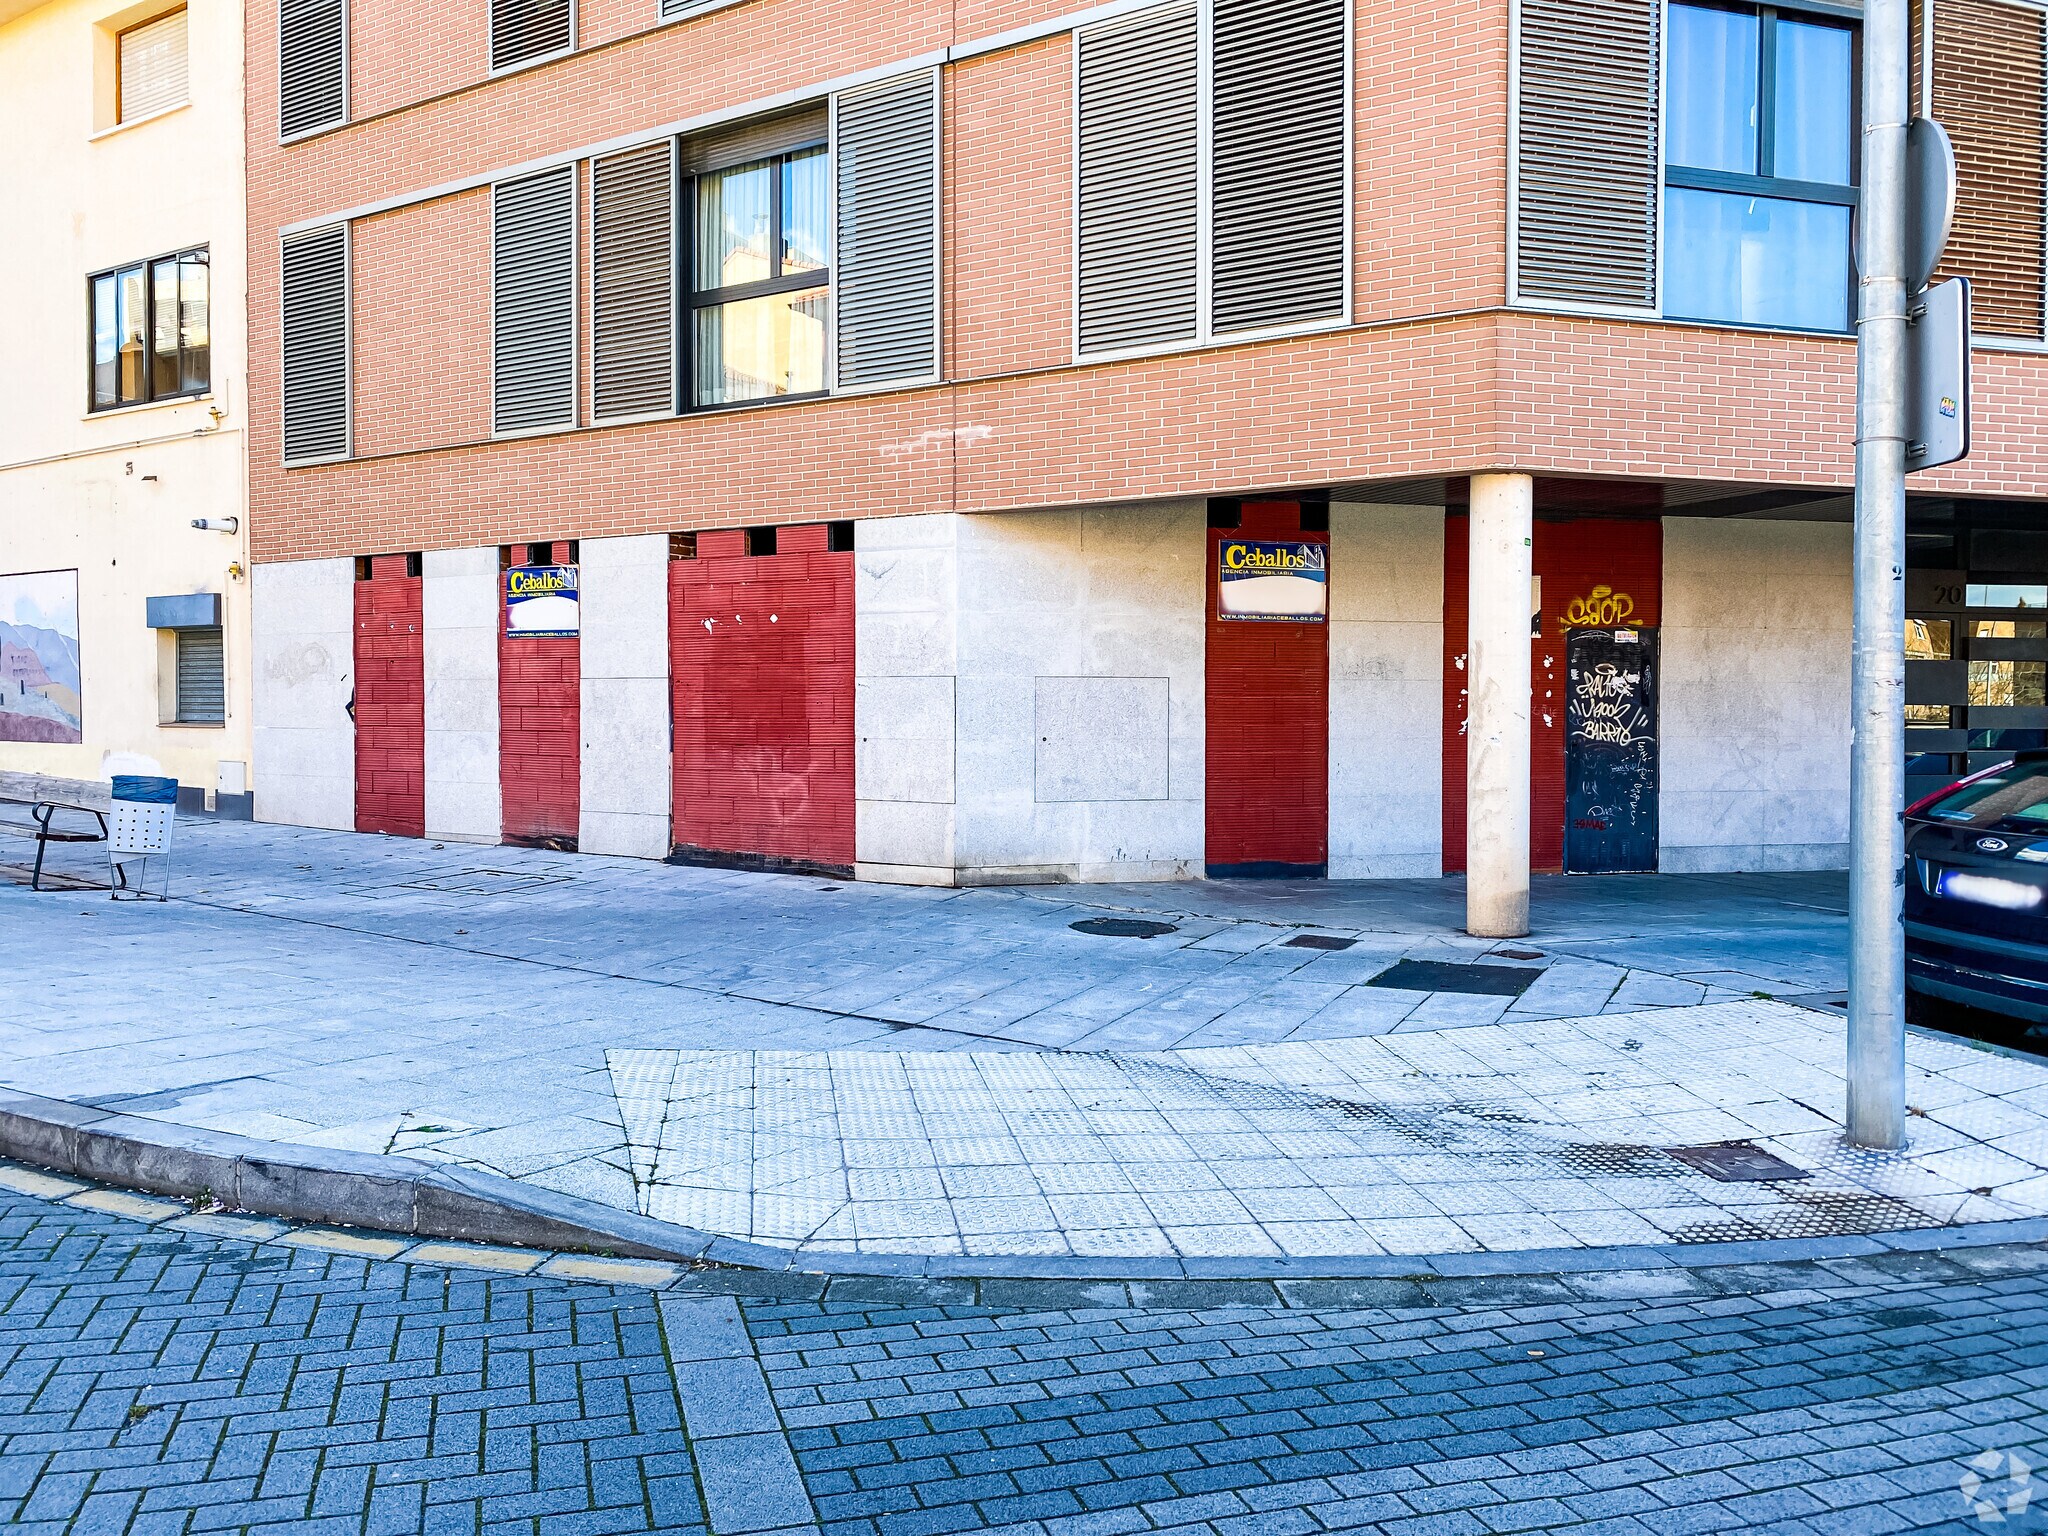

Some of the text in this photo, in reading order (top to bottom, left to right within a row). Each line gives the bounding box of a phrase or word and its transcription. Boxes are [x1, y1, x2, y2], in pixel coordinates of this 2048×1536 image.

[1226, 544, 1305, 570] Ceballos
[510, 571, 563, 594] Ceballos
[1891, 565, 1903, 581] 2
[1934, 584, 1963, 605] 20
